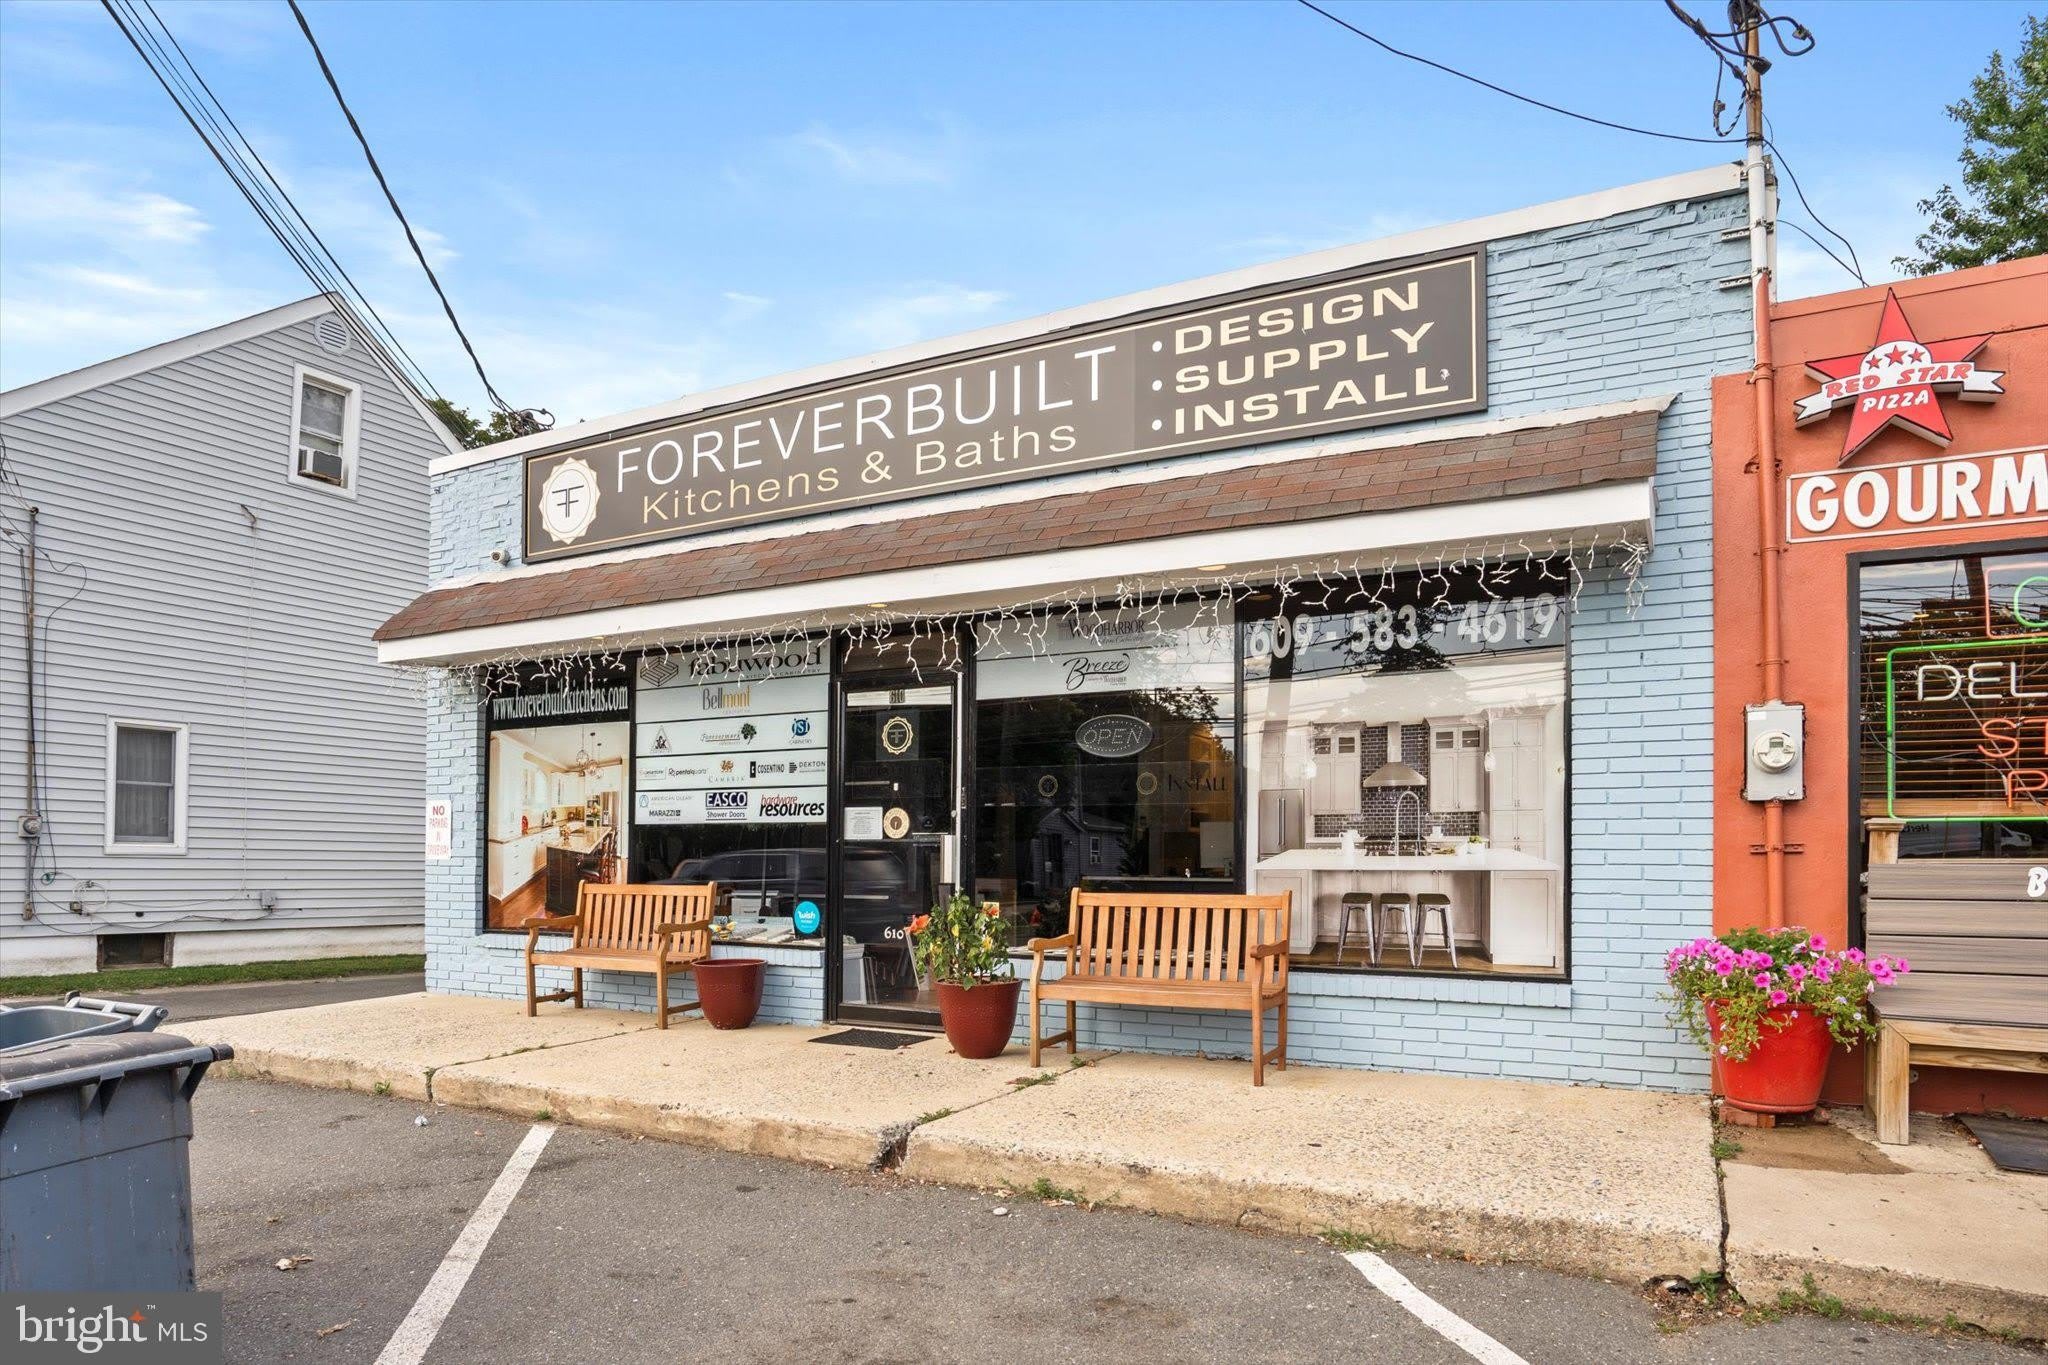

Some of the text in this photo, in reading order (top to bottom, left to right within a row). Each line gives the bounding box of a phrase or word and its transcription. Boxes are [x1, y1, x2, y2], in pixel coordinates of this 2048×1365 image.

[1175, 281, 1419, 355] DESIGN
[1175, 321, 1435, 394] SUPPLY
[1825, 363, 1973, 399] RED STAR
[1175, 367, 1449, 435] INSTALL
[1862, 389, 1929, 413] PIZZA
[616, 346, 1116, 493] FOREVERBUILT
[643, 424, 1077, 525] Kitchens & Baths
[1796, 453, 2048, 532] GOURM
[1249, 613, 1314, 659] 609
[1350, 604, 1419, 652] 583
[1458, 592, 1560, 644] 4619
[688, 645, 822, 676] fabuwood
[1063, 653, 1130, 691] Breeze
[493, 675, 628, 720] www.foreverbuiltkitchens.com
[702, 685, 752, 710] Bellmont
[1084, 728, 1143, 744] OPEN
[757, 763, 785, 774] COSENTINO
[432, 805, 445, 816] NO
[649, 809, 675, 817] MARAZZI
[706, 792, 746, 807] EASCO
[759, 802, 825, 817] resources
[761, 794, 798, 804] hardware
[729, 810, 746, 818] Doors
[884, 927, 904, 939] 610
